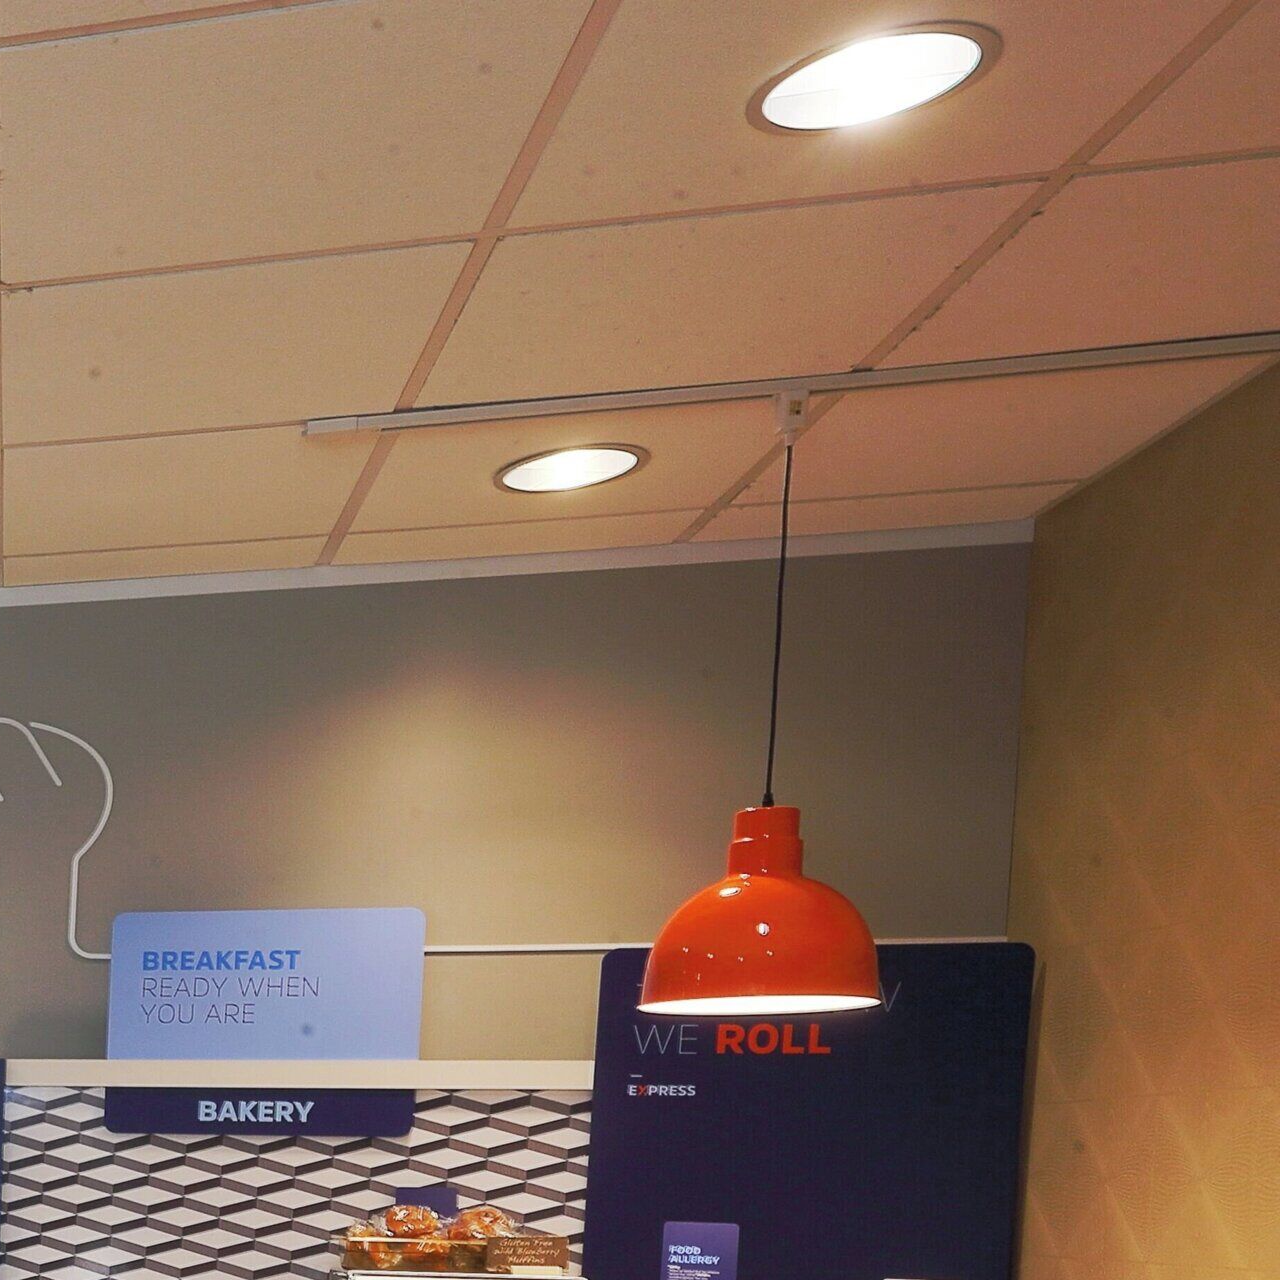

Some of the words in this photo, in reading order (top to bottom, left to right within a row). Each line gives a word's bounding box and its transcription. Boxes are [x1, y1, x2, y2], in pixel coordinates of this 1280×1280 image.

[142, 950, 301, 971] BREAKFAST
[142, 977, 228, 998] READY
[238, 976, 320, 997] WHEN
[140, 1003, 195, 1024] YOU
[204, 1003, 256, 1024] ARE
[633, 1024, 699, 1055] WE
[715, 1023, 831, 1055] ROLL
[627, 1084, 696, 1097] EXPRESS
[198, 1100, 315, 1123] BAKERY
[668, 1245, 701, 1255] FOOD
[668, 1254, 720, 1265] ALLERGY
